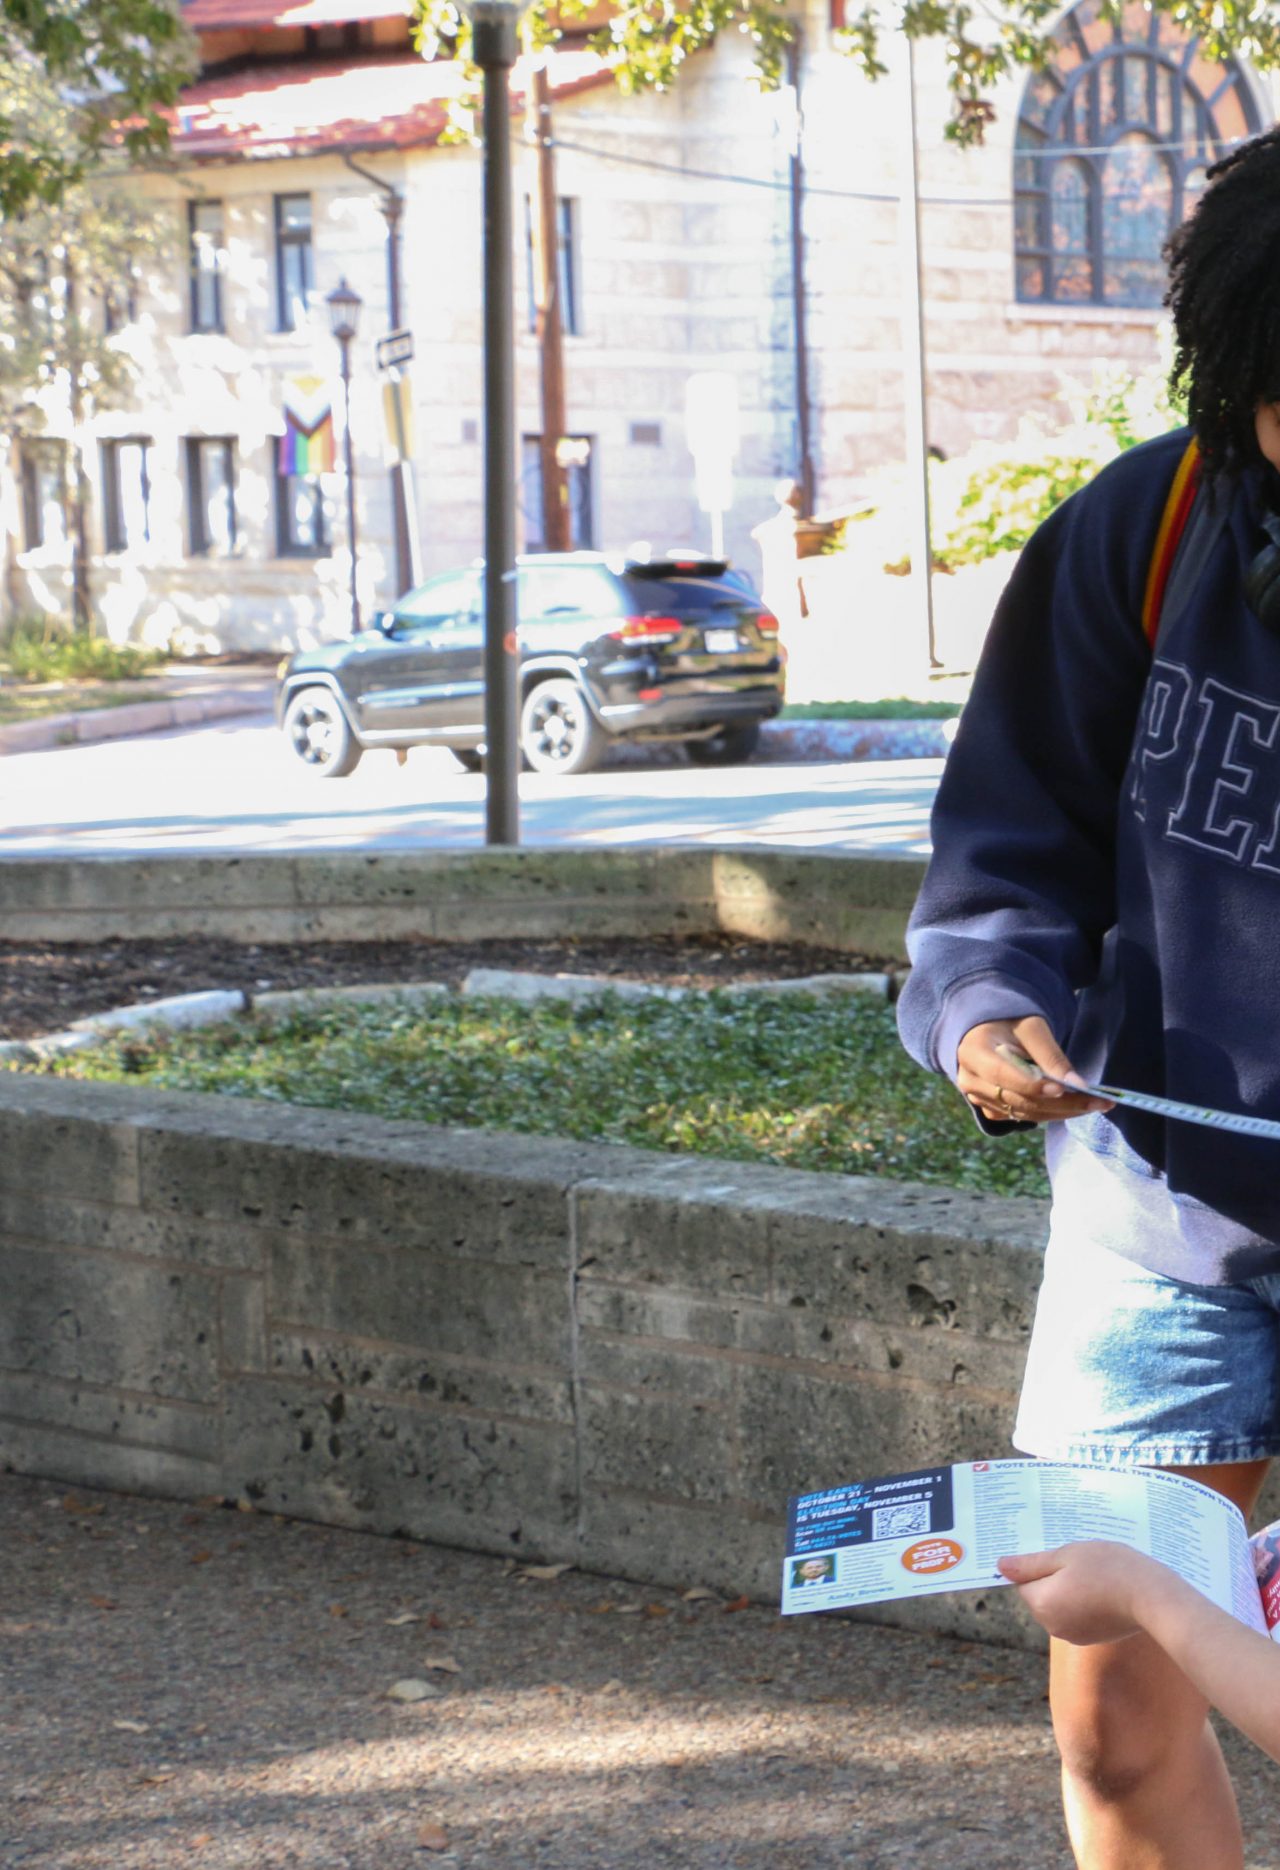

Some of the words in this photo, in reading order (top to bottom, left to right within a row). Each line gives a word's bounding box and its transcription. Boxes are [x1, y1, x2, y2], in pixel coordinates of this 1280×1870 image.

[797, 1494, 846, 1509] OCTOBER
[847, 1490, 861, 1499] 21
[874, 1476, 933, 1492] NOVEMBER
[1027, 1462, 1106, 1471] DEMOCRATIC
[1109, 1466, 1128, 1474] ALL
[1132, 1469, 1152, 1478] THE
[1154, 1473, 1180, 1484] WAY
[1182, 1481, 1216, 1500] DOWN
[1218, 1498, 1234, 1513] THE
[796, 1514, 808, 1523] IS
[811, 1504, 861, 1520] TUESDAY,
[863, 1492, 922, 1509] NOVEMBER
[912, 1546, 951, 1560] FOR
[912, 1557, 945, 1571] PROP
[948, 1555, 958, 1563] A
